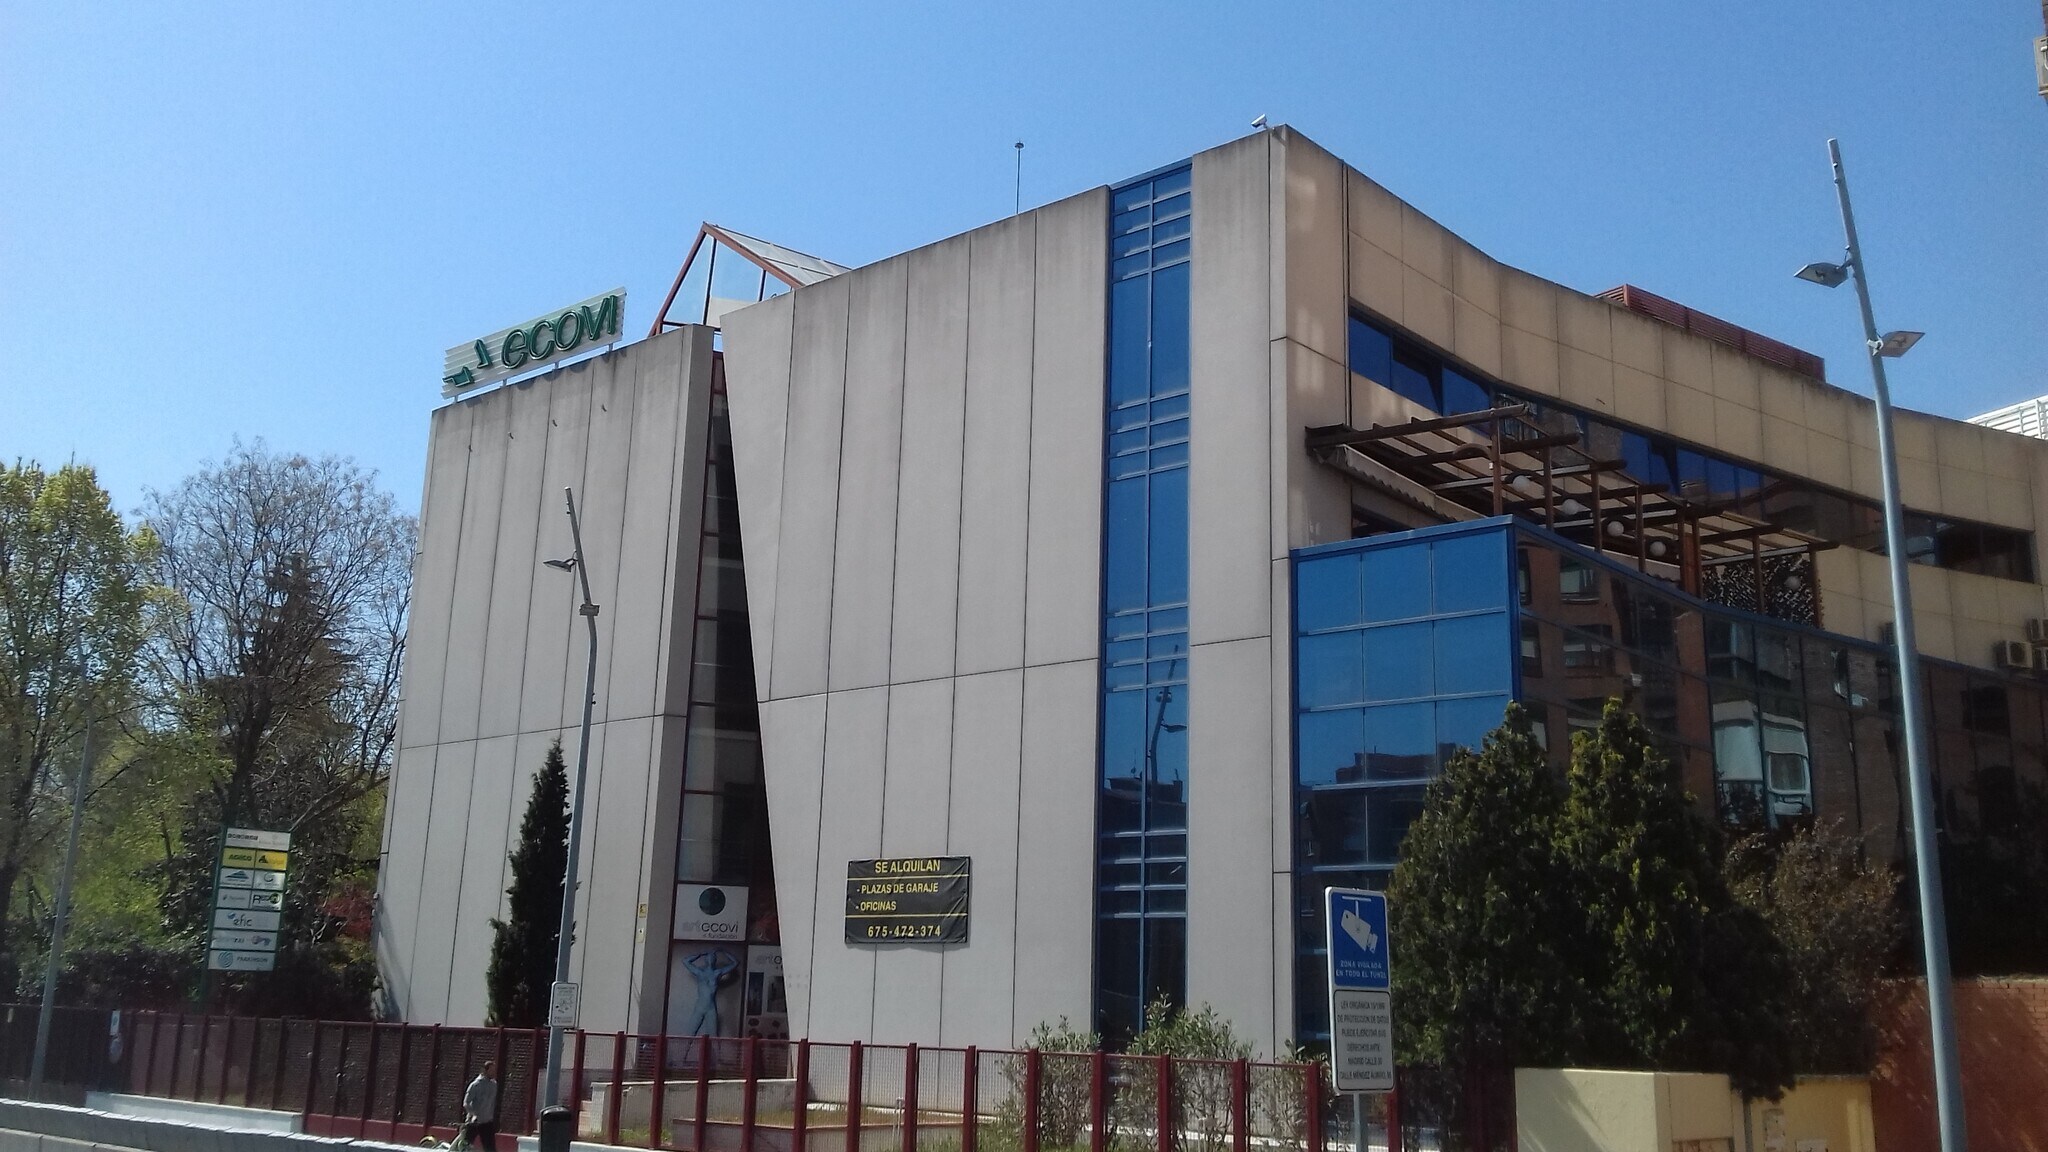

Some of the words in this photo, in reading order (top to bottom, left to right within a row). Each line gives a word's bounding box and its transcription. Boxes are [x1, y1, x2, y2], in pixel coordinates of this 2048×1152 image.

[875, 862, 888, 873] SE
[890, 860, 940, 873] ALQUILAN
[861, 884, 892, 894] PLAZAS
[893, 884, 904, 893] DE
[906, 883, 939, 893] GARAJE
[860, 901, 897, 911] OFICINAS
[867, 925, 941, 937] 675-472-374
[1336, 969, 1344, 977] EN
[1345, 970, 1360, 978] TODO
[1361, 970, 1369, 978] EL
